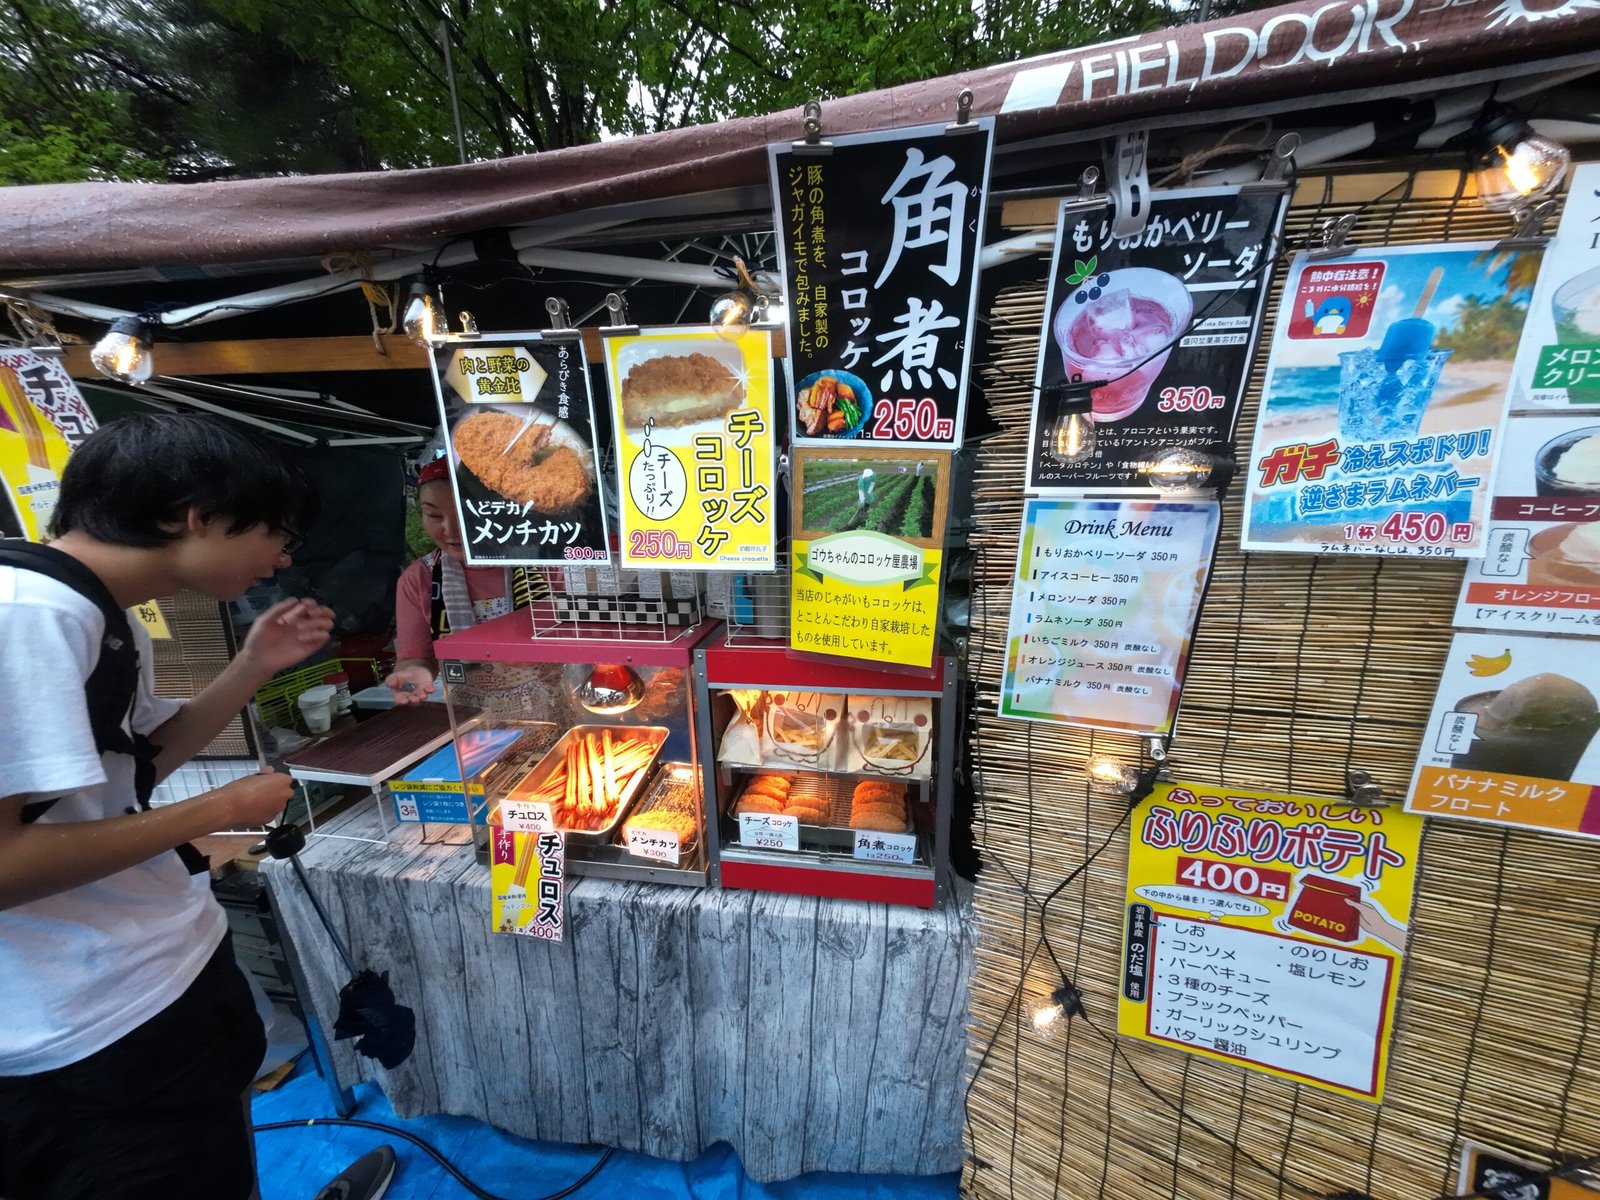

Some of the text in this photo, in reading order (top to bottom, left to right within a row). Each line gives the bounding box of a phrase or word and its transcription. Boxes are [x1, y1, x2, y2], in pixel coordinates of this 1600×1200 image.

[968, 185, 982, 232] かく
[788, 166, 812, 359] ジャガイモで包みました。
[872, 147, 969, 393] 角煮
[1183, 243, 1263, 280] ソーダ
[840, 250, 870, 369] コロッケ
[459, 355, 530, 375] 肉と野菜の
[477, 377, 521, 395] 黄金比
[557, 345, 570, 419] あらびき食感
[1158, 386, 1226, 413] 350円
[873, 398, 954, 440] 250円
[728, 411, 768, 524] チーズ
[1258, 439, 1342, 488] ガチ
[658, 453, 673, 508] チーズ
[1299, 471, 1480, 514] 逆さまラムネバー
[695, 436, 729, 557] コロッケ
[472, 518, 582, 545] メンチカツ
[1064, 518, 1173, 539] Drink Menu
[563, 546, 607, 560] 300円
[629, 529, 692, 559] 250円
[1044, 548, 1146, 561] もりおかベリーソーダ
[1497, 533, 1515, 573] 炭酸なし
[811, 549, 918, 571] ゴウちゃんのコロッケ屋農場
[1040, 570, 1111, 582] アイスコーヒー
[796, 589, 926, 615] 当店のじゃがいもコロッケは、
[1037, 593, 1097, 605] メロンソーダ
[796, 610, 931, 637] とことんこだわり自家栽培した
[1035, 614, 1093, 627] ラムネソーダ
[796, 632, 893, 655] ものを使用しています。
[1031, 635, 1088, 648] いちごミルク
[1124, 644, 1157, 653] 炭酸なし
[1028, 656, 1104, 669] オレンジジュース
[1137, 666, 1170, 676] 炭酸なし
[1025, 676, 1081, 688] バナナミルク
[1116, 685, 1149, 695] 炭酸なし
[1448, 716, 1466, 752] 炭酸なし
[1433, 774, 1567, 802] バナナミルク
[508, 810, 547, 822] チュロス
[1167, 788, 1384, 825] ふっておいしい
[1430, 794, 1511, 816] フロート
[631, 836, 677, 849] メンチカツ
[756, 839, 783, 848] ¥250
[1142, 807, 1405, 881] ふりふりポテト
[539, 833, 561, 926] チュロス
[1181, 860, 1286, 900] 400円
[1174, 922, 1206, 937] しお
[1293, 909, 1346, 933] POTATO
[1129, 942, 1145, 977] のだ塩
[1172, 939, 1236, 961] コンソメ
[1290, 945, 1370, 972] のりしお
[1169, 957, 1271, 984] バーベキュー
[1288, 962, 1366, 989] 塩レモン
[1129, 981, 1140, 998] 使用
[1167, 991, 1304, 1029] ブラックペッパー
[1165, 1024, 1247, 1057] バター醤油
[1166, 1007, 1342, 1060] ガーリックシュリンプ
